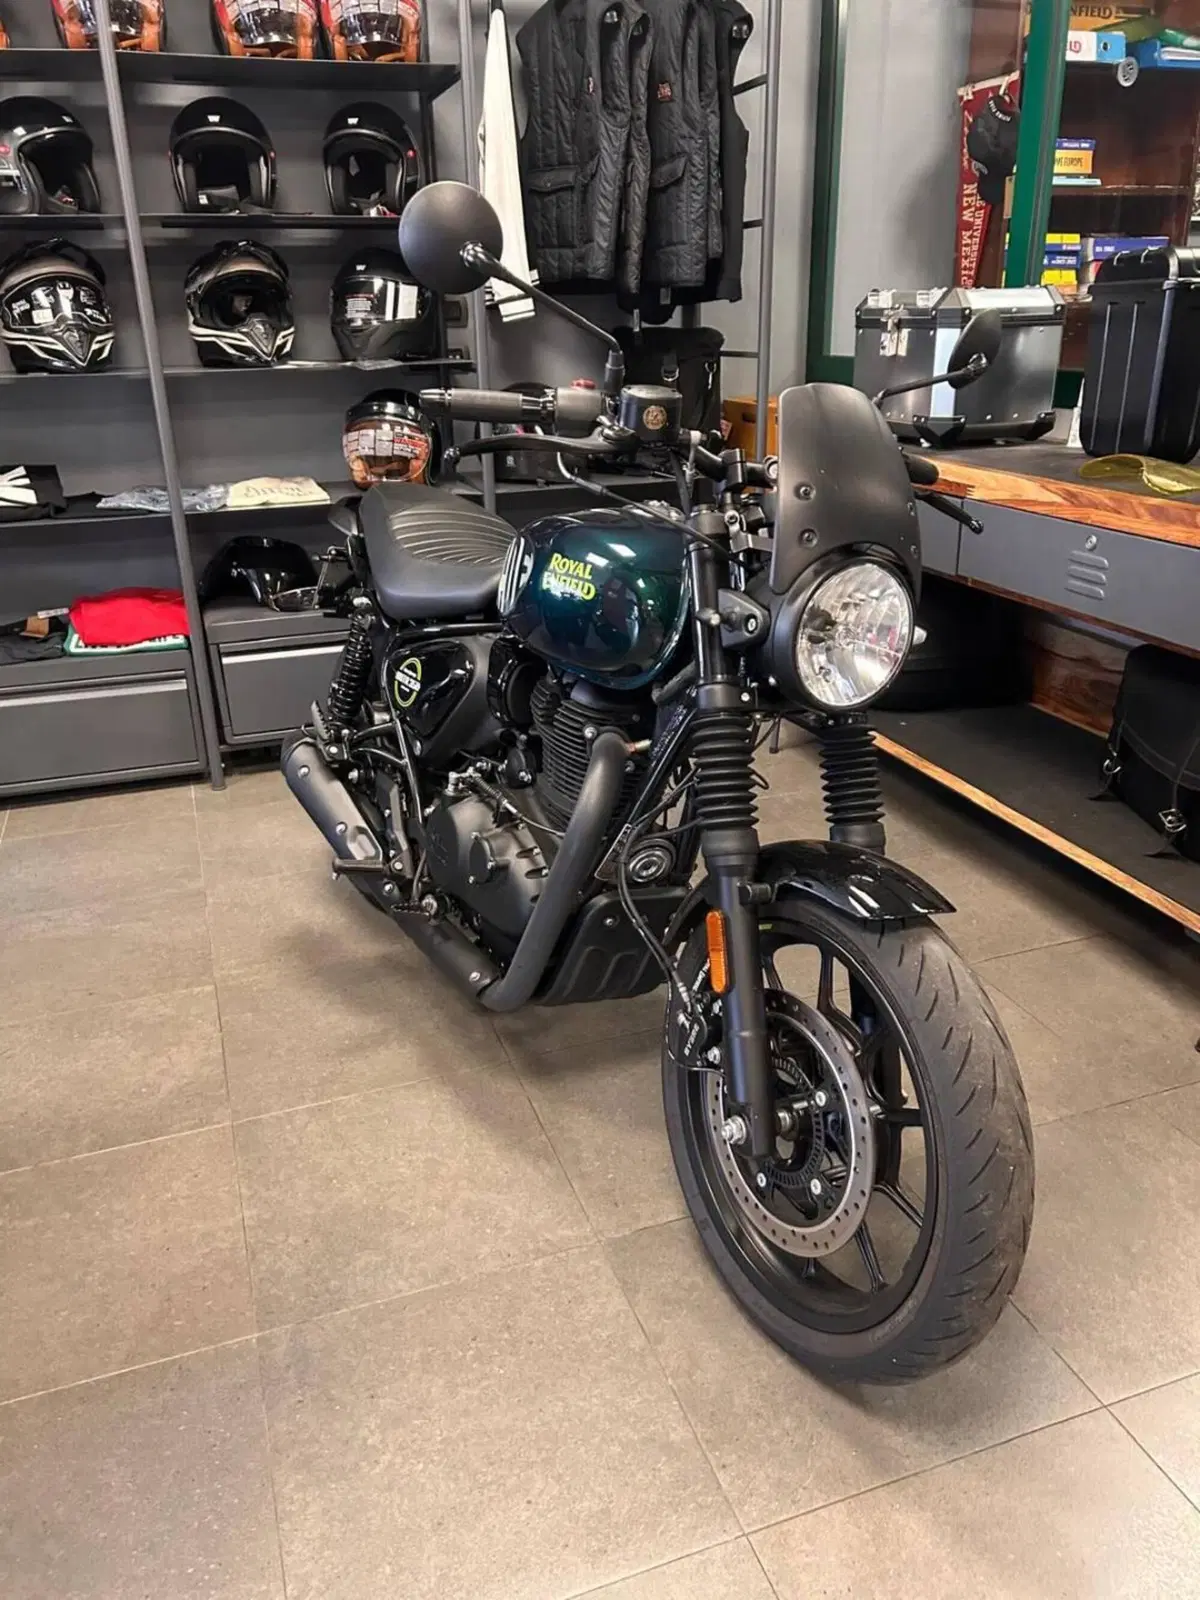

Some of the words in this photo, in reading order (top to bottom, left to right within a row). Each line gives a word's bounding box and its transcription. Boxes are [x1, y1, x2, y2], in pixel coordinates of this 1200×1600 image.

[962, 183, 978, 223] NEW
[970, 210, 985, 278] UNIVERSITY
[549, 553, 593, 579] ROYAL
[542, 571, 596, 600] ENFIELD
